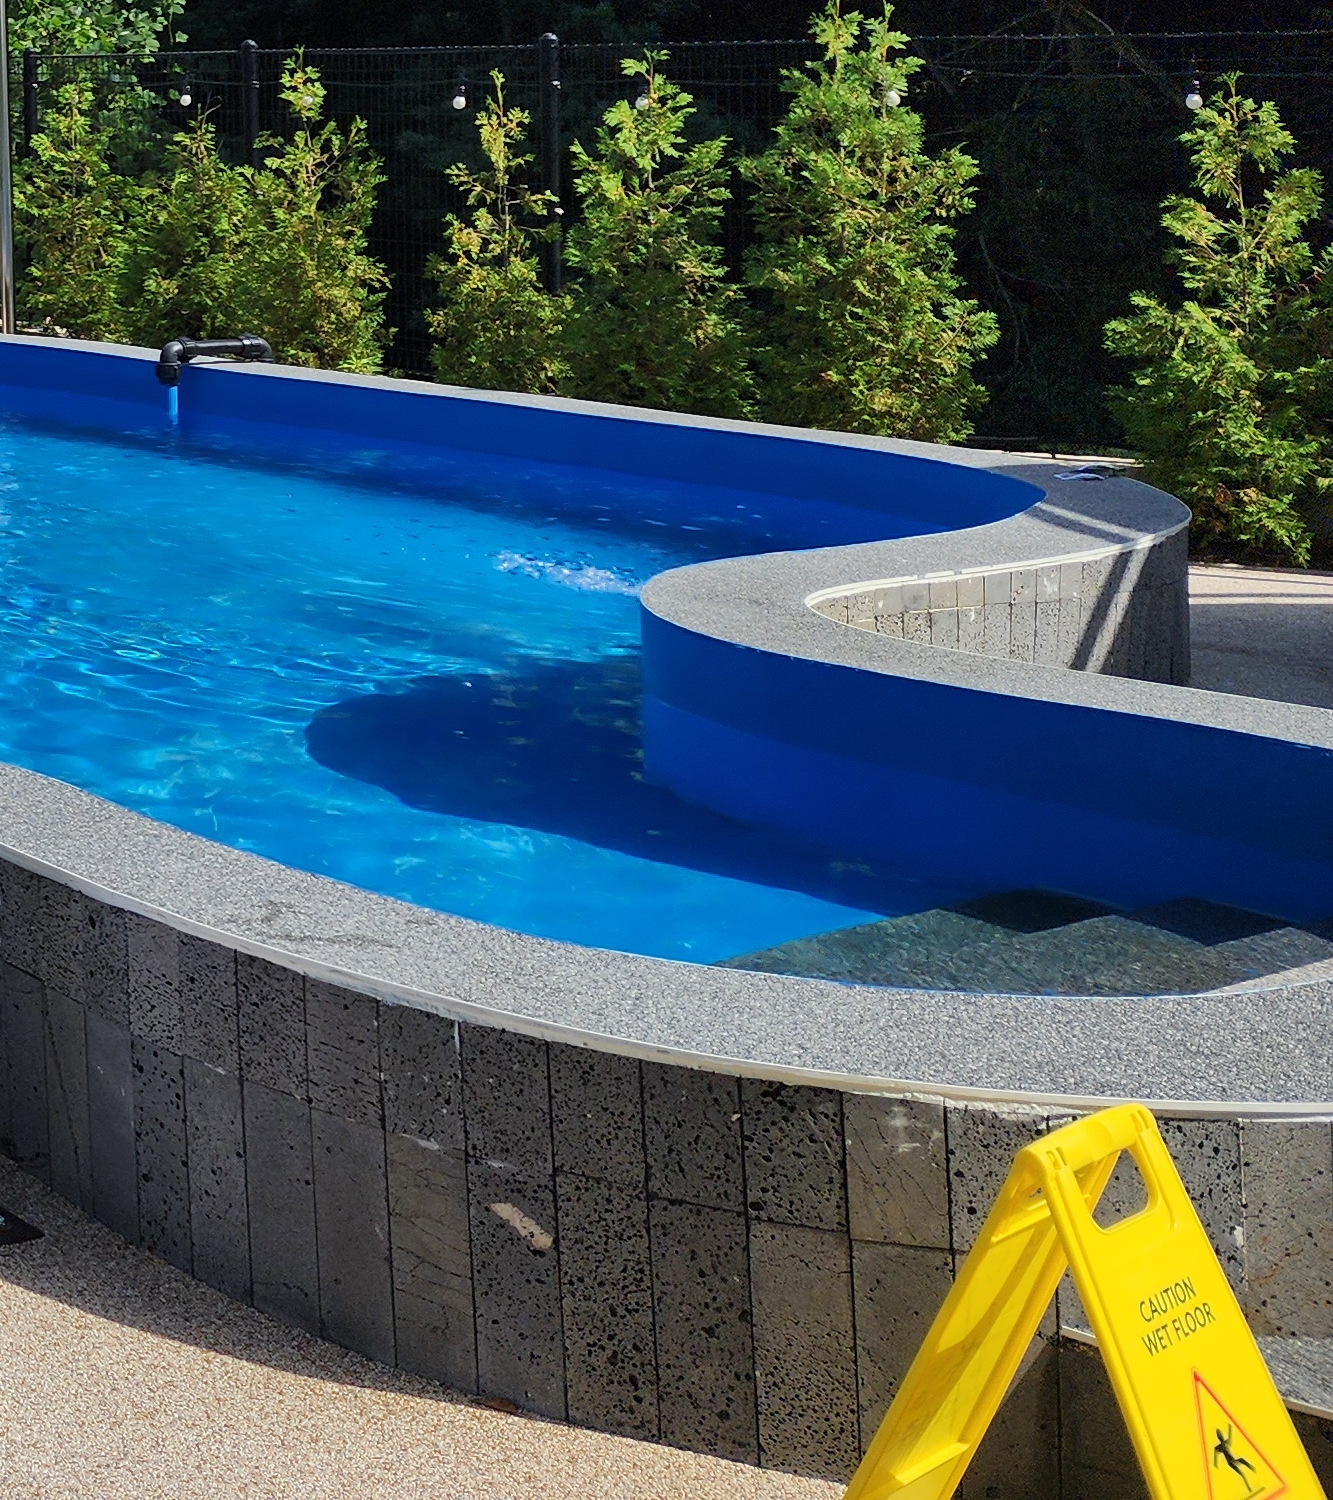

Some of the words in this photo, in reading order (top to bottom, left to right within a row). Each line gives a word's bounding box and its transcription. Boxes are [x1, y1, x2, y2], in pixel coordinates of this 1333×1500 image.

[1139, 1276, 1197, 1322] CAUTION
[1141, 1326, 1173, 1357] WET
[1172, 1302, 1216, 1341] FLOOR
